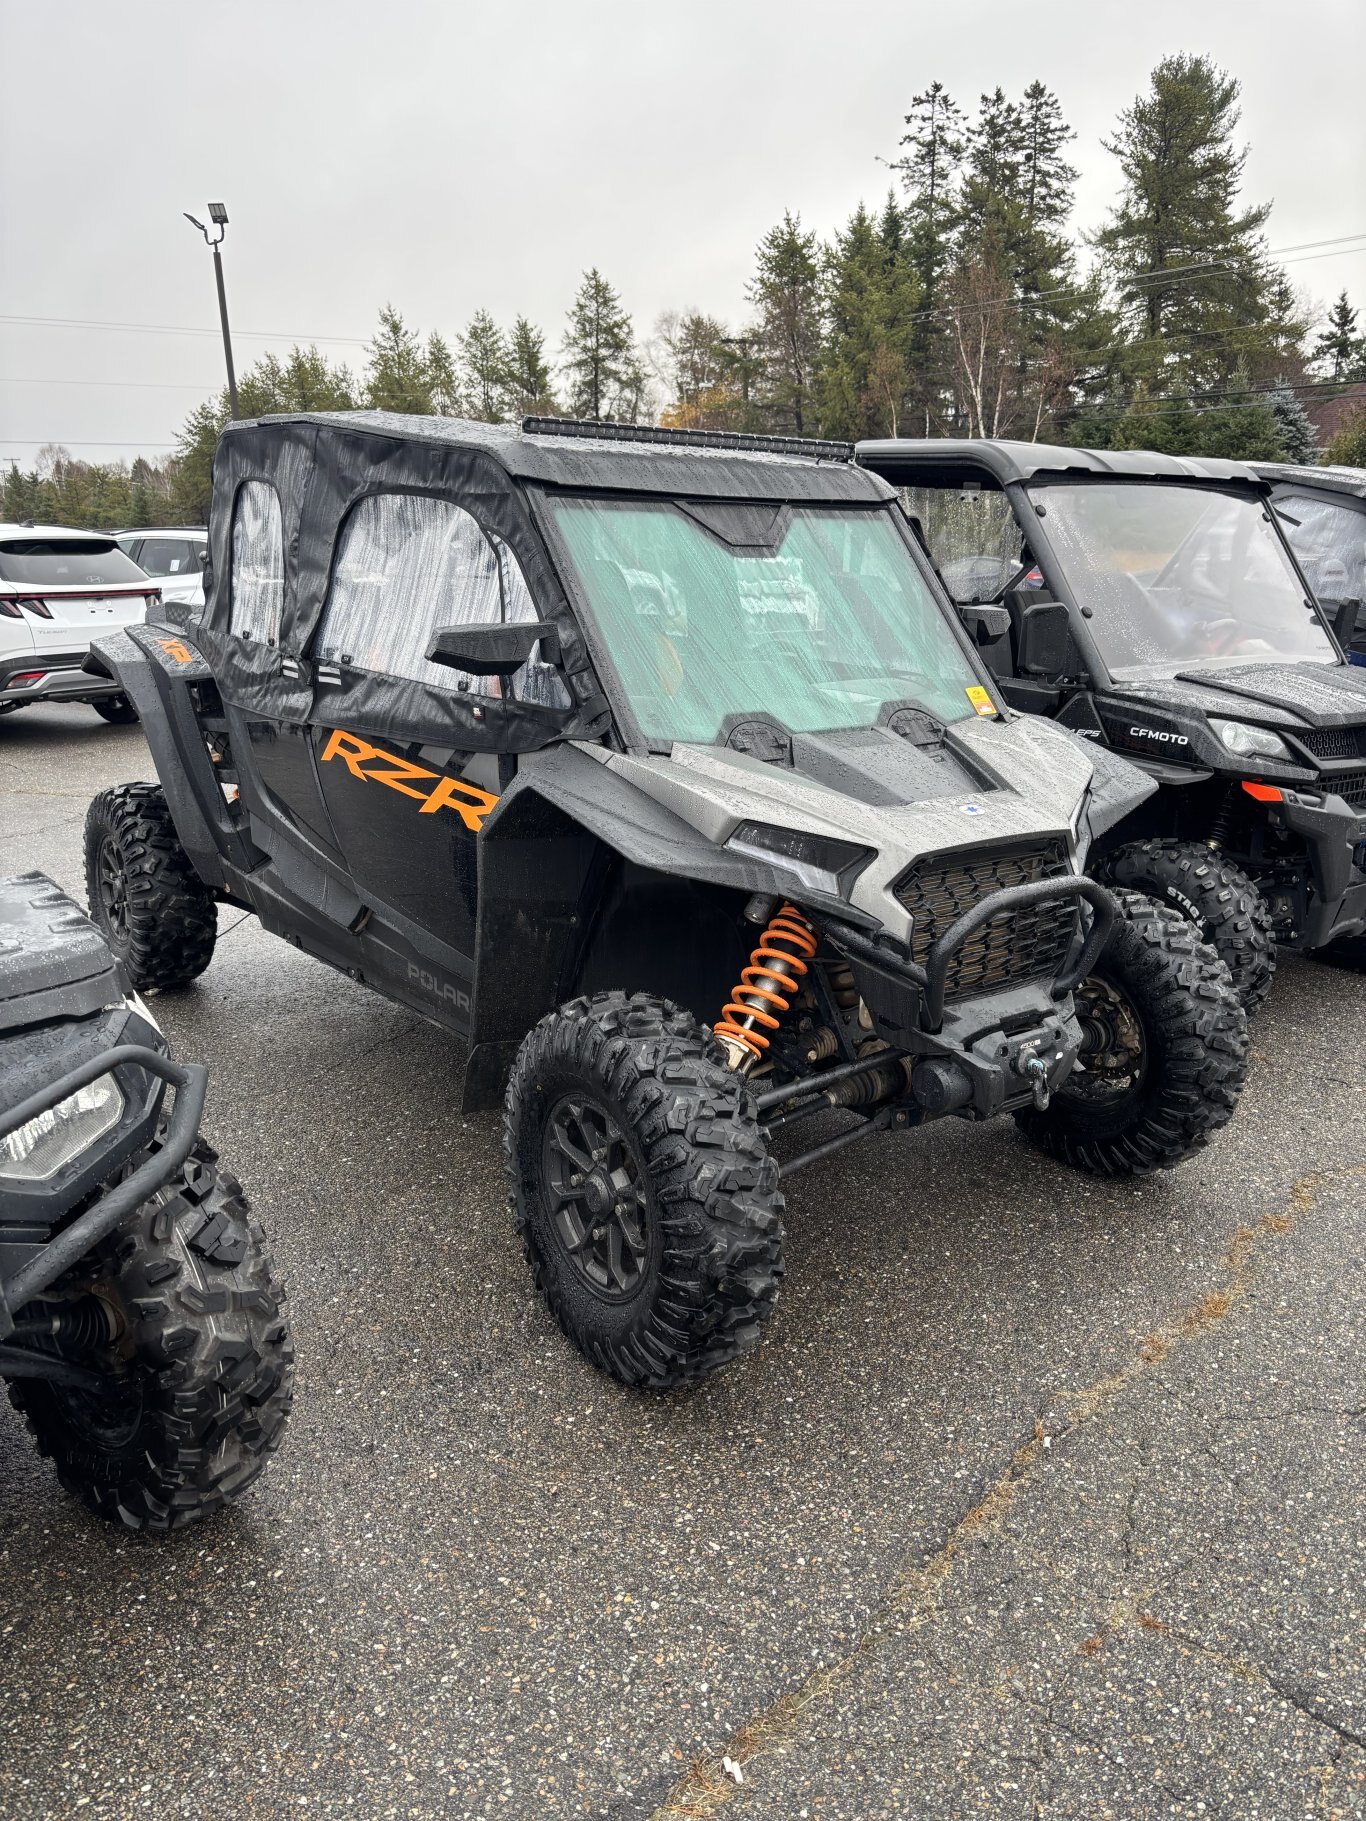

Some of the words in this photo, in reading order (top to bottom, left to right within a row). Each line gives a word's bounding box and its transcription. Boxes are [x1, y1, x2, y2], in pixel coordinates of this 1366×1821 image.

[155, 638, 193, 663] XP
[1130, 726, 1189, 745] CFMOTO
[321, 729, 500, 833] RZR
[1166, 886, 1200, 919] STAG
[407, 961, 474, 1013] POLAR
